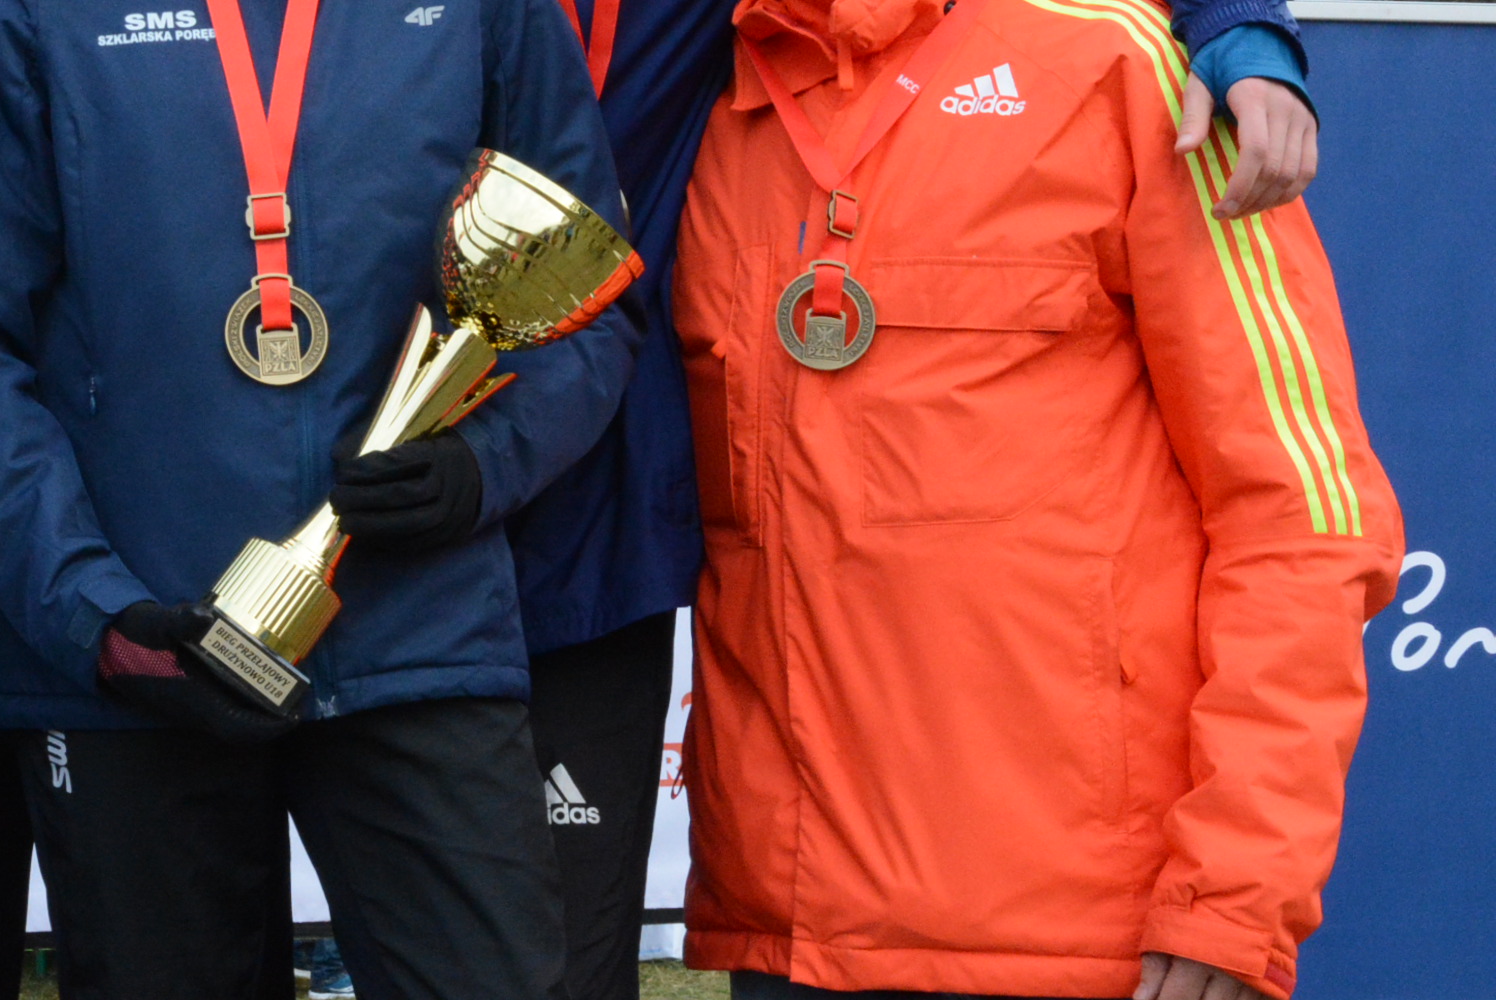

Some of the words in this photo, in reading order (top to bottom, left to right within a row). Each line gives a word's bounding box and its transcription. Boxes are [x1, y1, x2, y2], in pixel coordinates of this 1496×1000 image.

[124, 10, 197, 31] SMS
[404, 5, 445, 27] 4F
[97, 30, 173, 47] SZKLARSKA
[175, 28, 216, 41] PORĘB
[896, 73, 921, 94] MCC
[940, 94, 1027, 116] adidas
[264, 361, 297, 373] PZLA
[215, 626, 238, 646] BIEG
[235, 642, 291, 687] PRZEŁAJOWY
[211, 640, 266, 685] DRUŻYNOWO
[264, 681, 284, 699] U18
